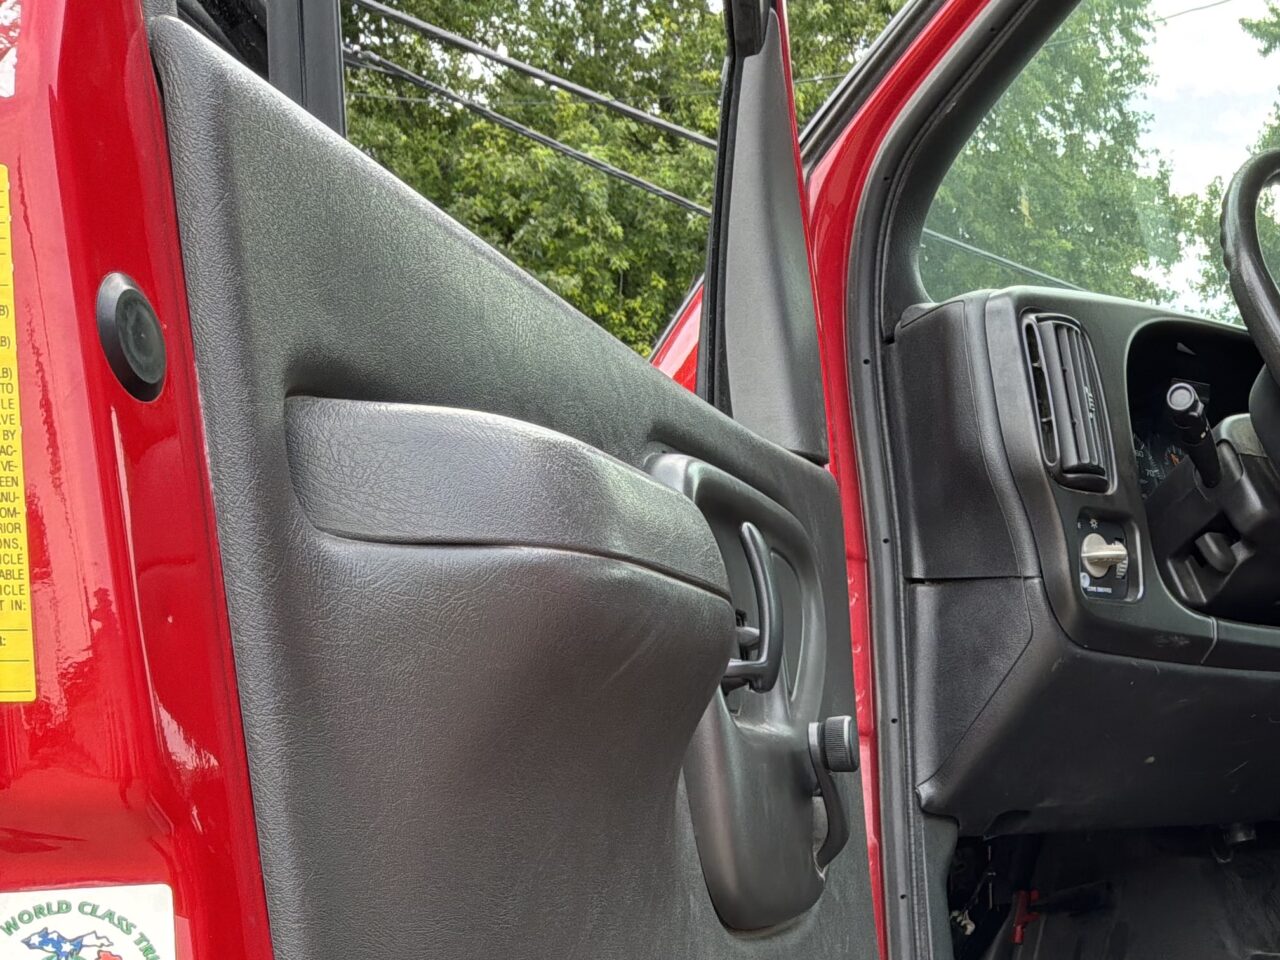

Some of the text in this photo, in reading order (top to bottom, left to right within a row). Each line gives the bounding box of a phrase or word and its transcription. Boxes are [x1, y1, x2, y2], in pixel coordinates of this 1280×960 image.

[0, 413, 16, 426] VE
[2, 429, 16, 441] BY
[0, 900, 72, 936] WORLD
[78, 901, 137, 935] CLASS
